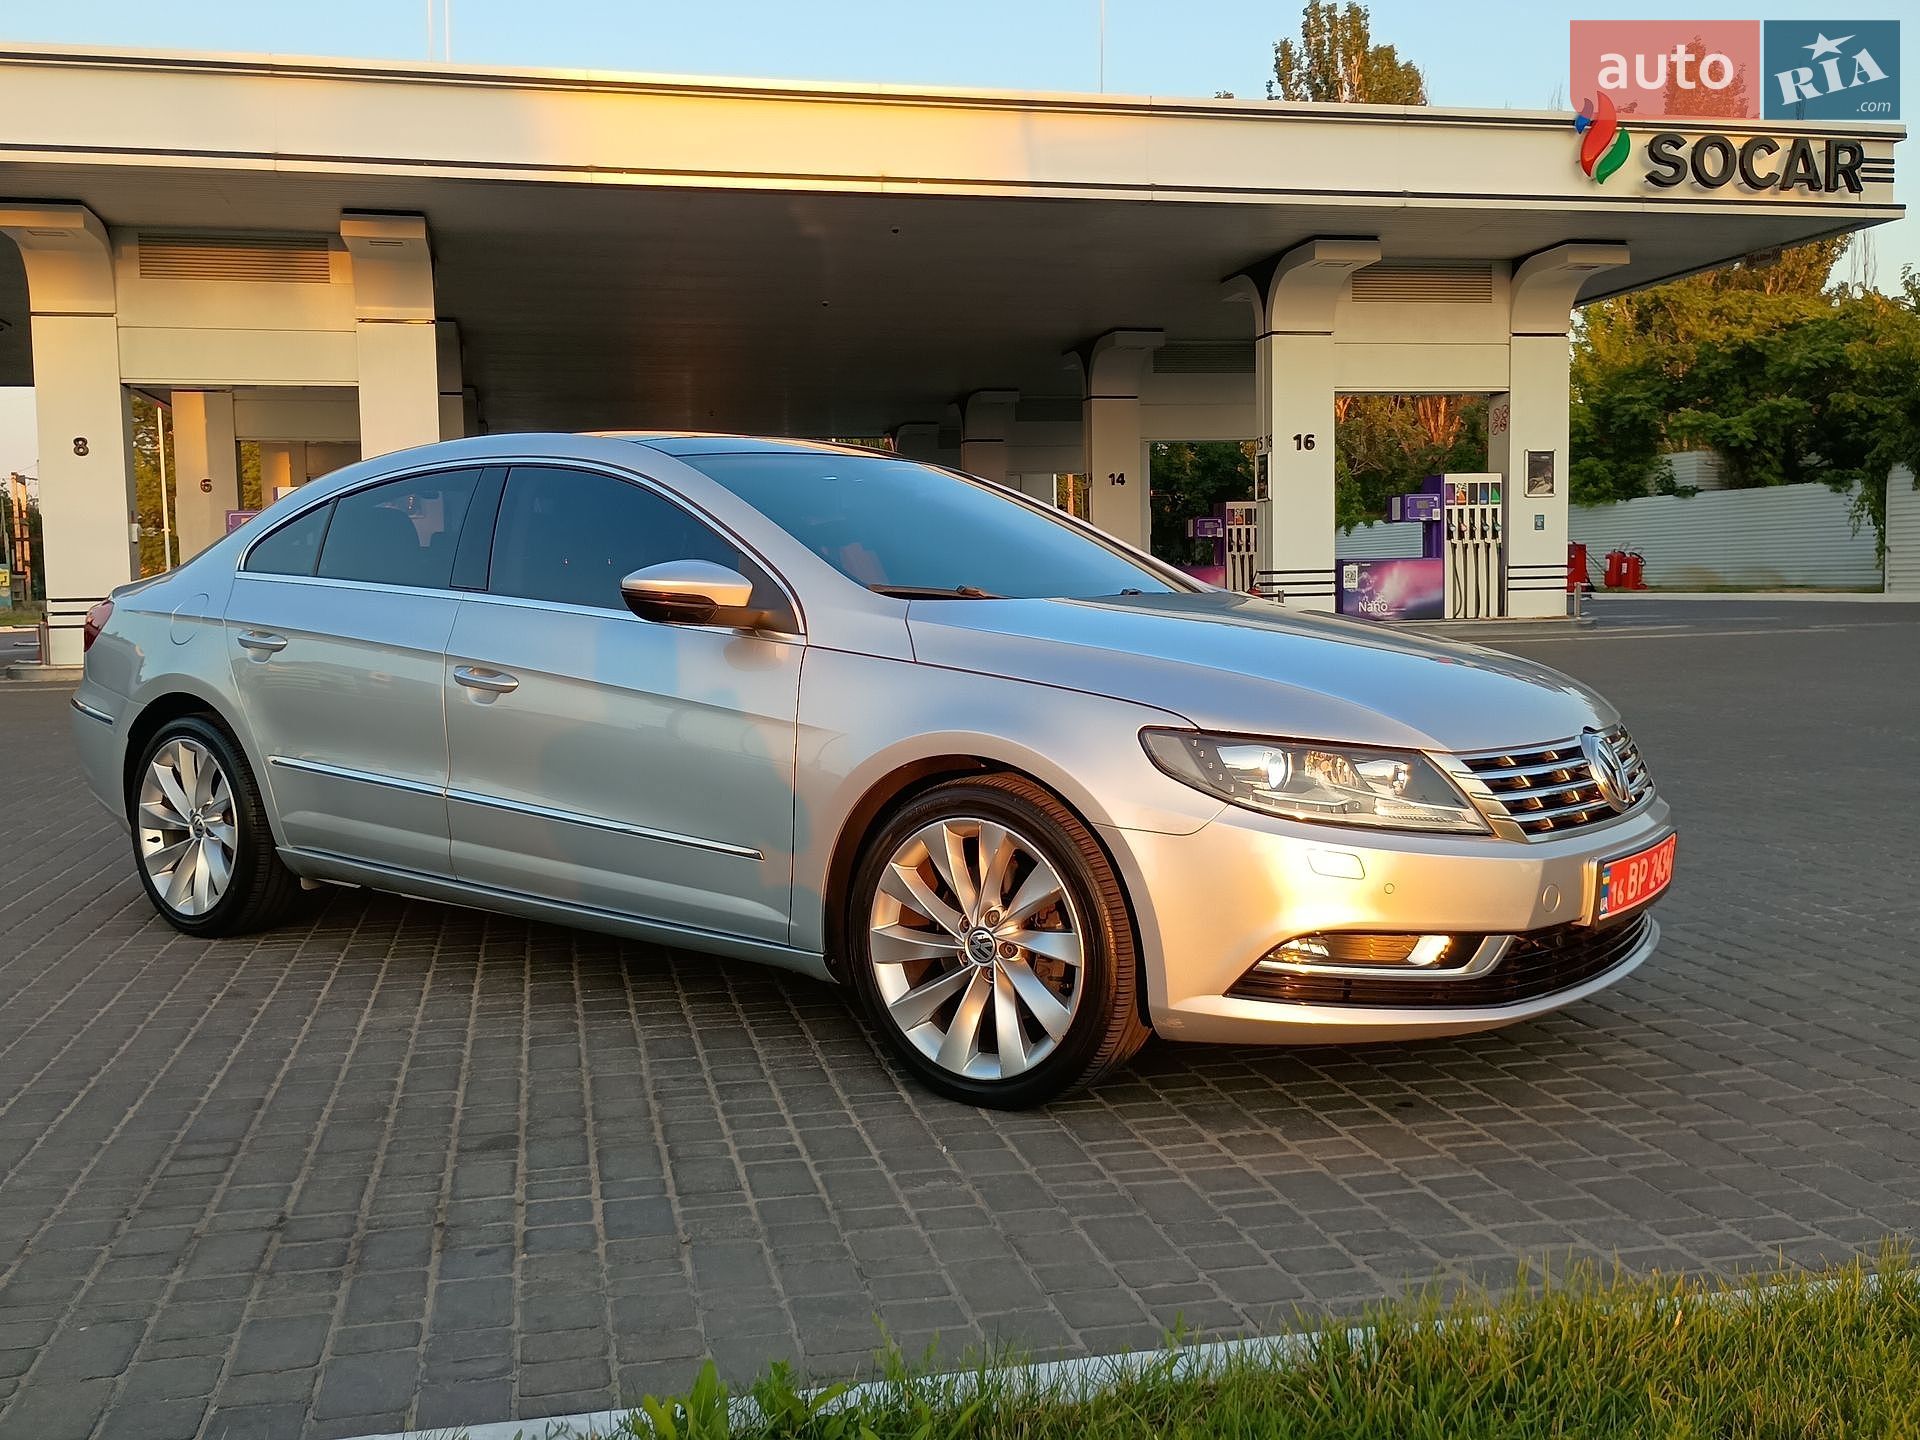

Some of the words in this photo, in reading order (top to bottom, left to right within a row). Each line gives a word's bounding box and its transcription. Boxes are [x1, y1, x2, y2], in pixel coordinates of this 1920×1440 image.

[1645, 133, 1864, 194] SOCAR
[73, 437, 89, 456] 8
[1293, 433, 1316, 451] 16
[200, 478, 213, 493] 6
[1108, 472, 1126, 486] 14
[1611, 878, 1624, 908] 16
[1627, 857, 1649, 900] BP
